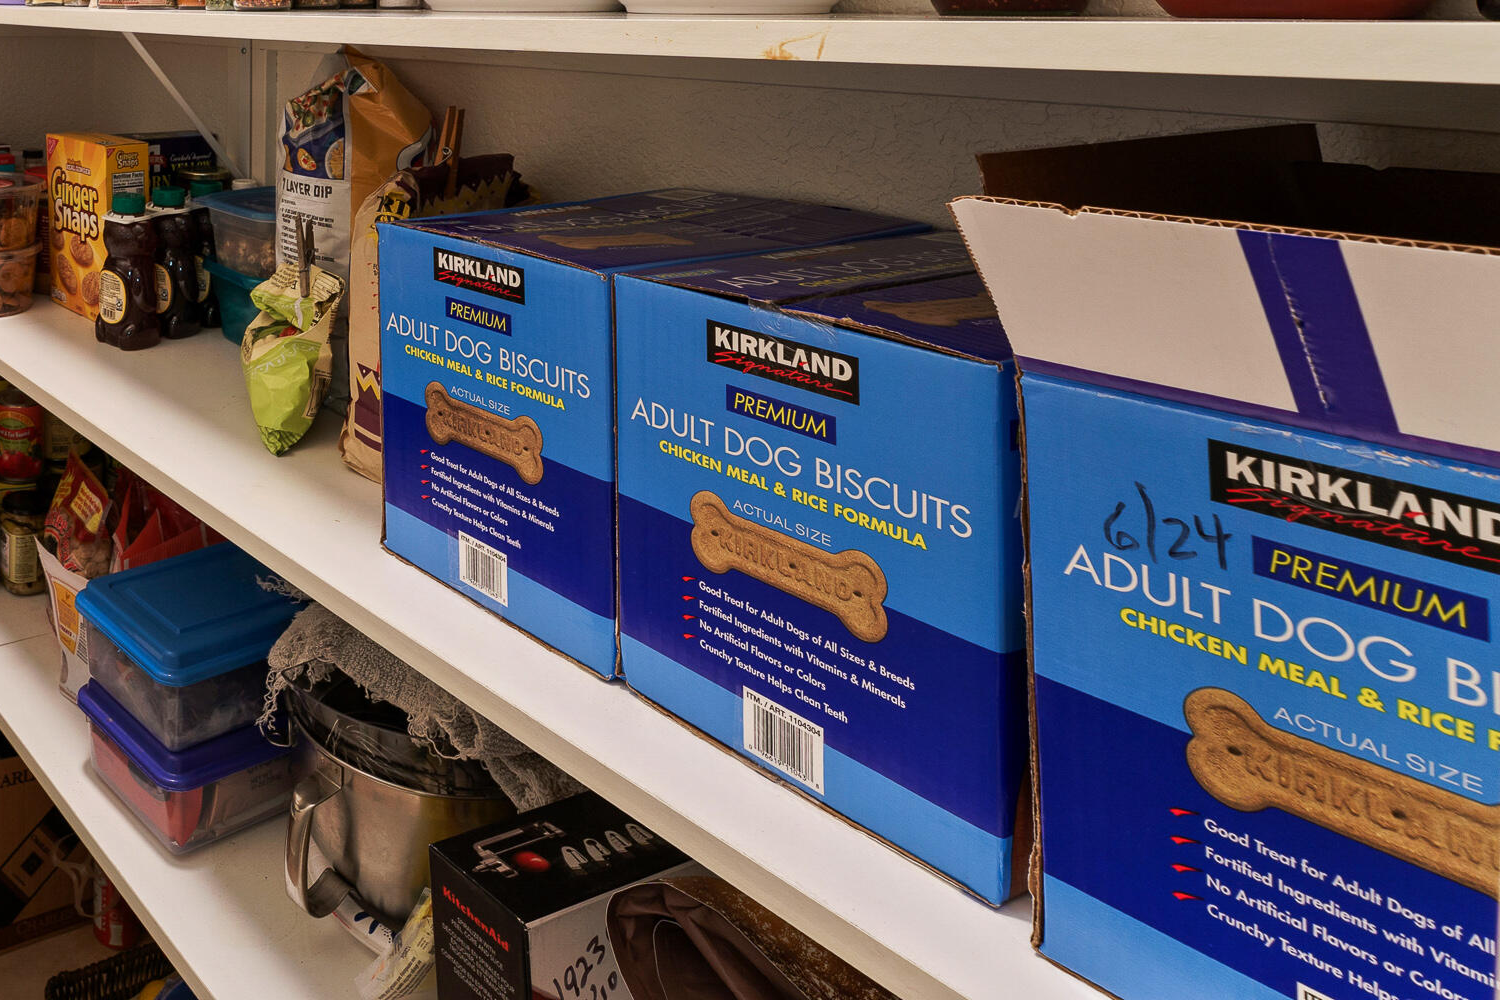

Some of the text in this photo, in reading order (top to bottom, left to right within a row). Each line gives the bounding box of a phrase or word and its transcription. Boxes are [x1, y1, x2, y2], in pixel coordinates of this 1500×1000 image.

[51, 166, 99, 213] Ginger
[116, 150, 139, 161] Ginger
[117, 159, 139, 170] Snaps
[286, 181, 311, 196] LAYER
[313, 185, 333, 198] DIP
[54, 198, 99, 243] Snaps
[438, 251, 521, 288] KIRKLAND
[438, 270, 521, 299] Signature
[450, 301, 507, 332] PREMIUM
[386, 312, 591, 399] ADULT DOG BISCUITS
[404, 344, 566, 411] CHICKEN MEAL & RICE FORMULA
[713, 350, 853, 397] Signature
[714, 327, 853, 383] KIRKLAND
[451, 385, 511, 416] ACTUAL SIZE
[733, 392, 827, 438] PREMIUM
[630, 397, 973, 539] ADULT DOG BISCUITS
[658, 439, 927, 551] CHICKEN MEAL & RICE FORMULA
[1225, 451, 1500, 544] KIRKLAND
[733, 499, 832, 548] ACTUAL SIZE
[1102, 481, 1233, 572] 6/24
[1225, 487, 1500, 563] Signature
[1063, 543, 1417, 683] ADULT DOG
[1269, 548, 1468, 629] PREMIUM
[699, 580, 915, 691] Good Treat for Adult Dogs of All Sizes & Breeds
[699, 600, 907, 710] Fortified Ingredients with Vitamins & Minerals
[699, 619, 827, 691] No Artificial Flavors or Colors
[699, 639, 848, 724] Crunchy Texture Helps Clean Teeth
[1119, 608, 1476, 744] CHICKEN MEAL & RICE
[1273, 706, 1485, 796] ACTUAL SIZE
[442, 885, 509, 953] KitchenAid
